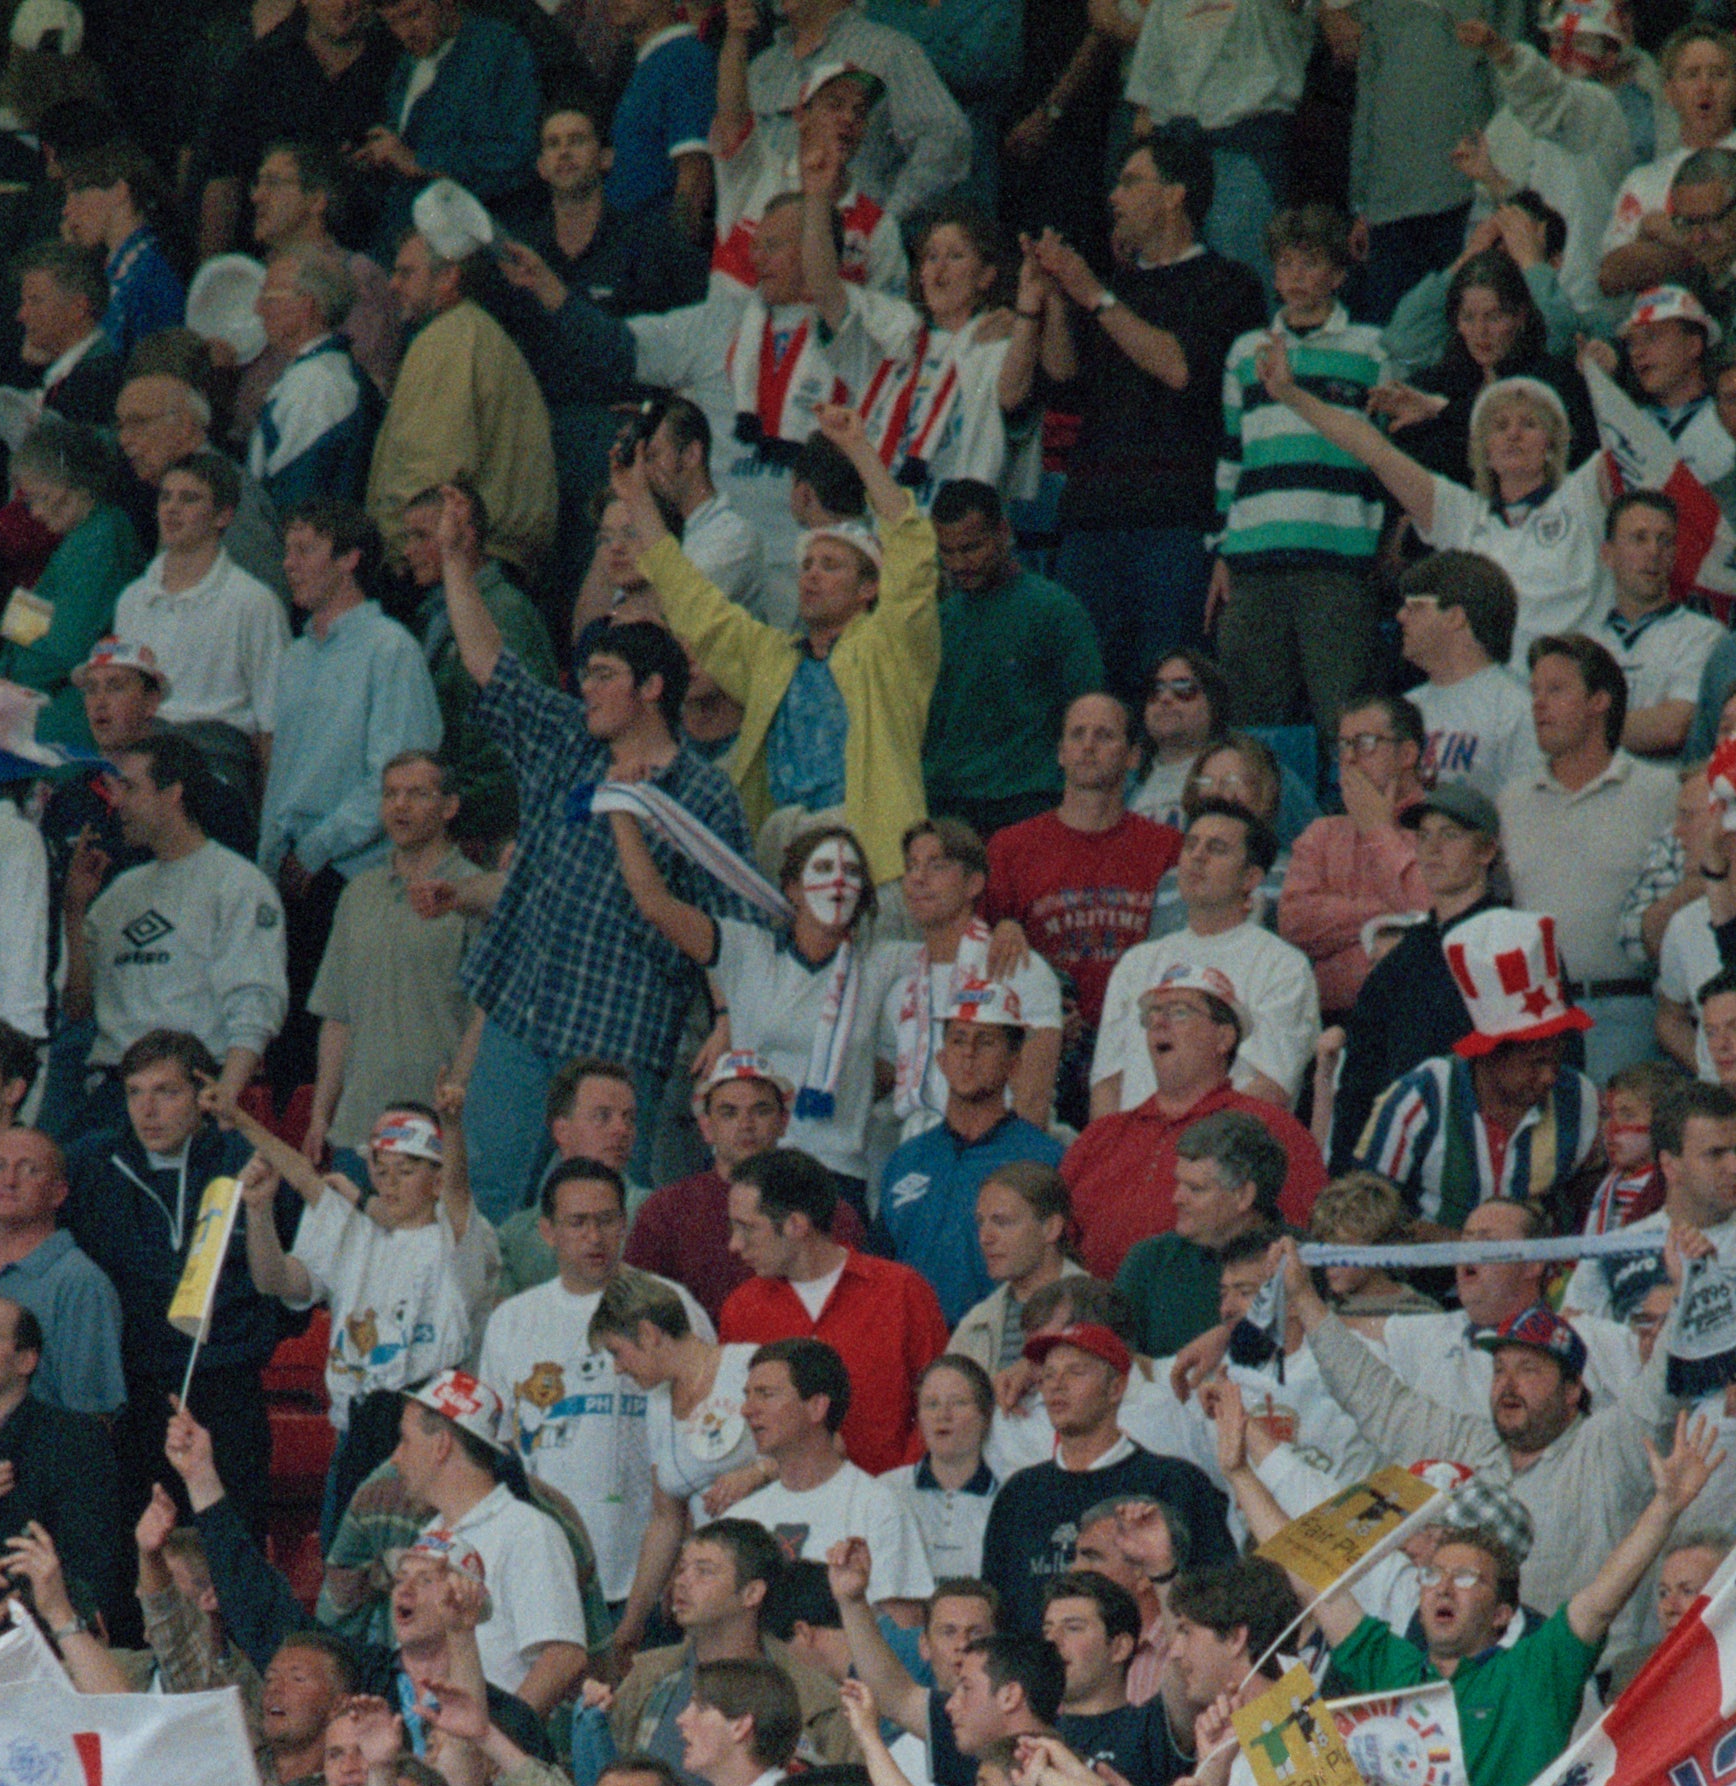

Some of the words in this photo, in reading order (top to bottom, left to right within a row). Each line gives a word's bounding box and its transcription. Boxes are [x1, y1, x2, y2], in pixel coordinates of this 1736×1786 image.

[1300, 1515, 1334, 1544] Fair
[1331, 1536, 1363, 1564] Pl
[1326, 1745, 1353, 1774] Pl
